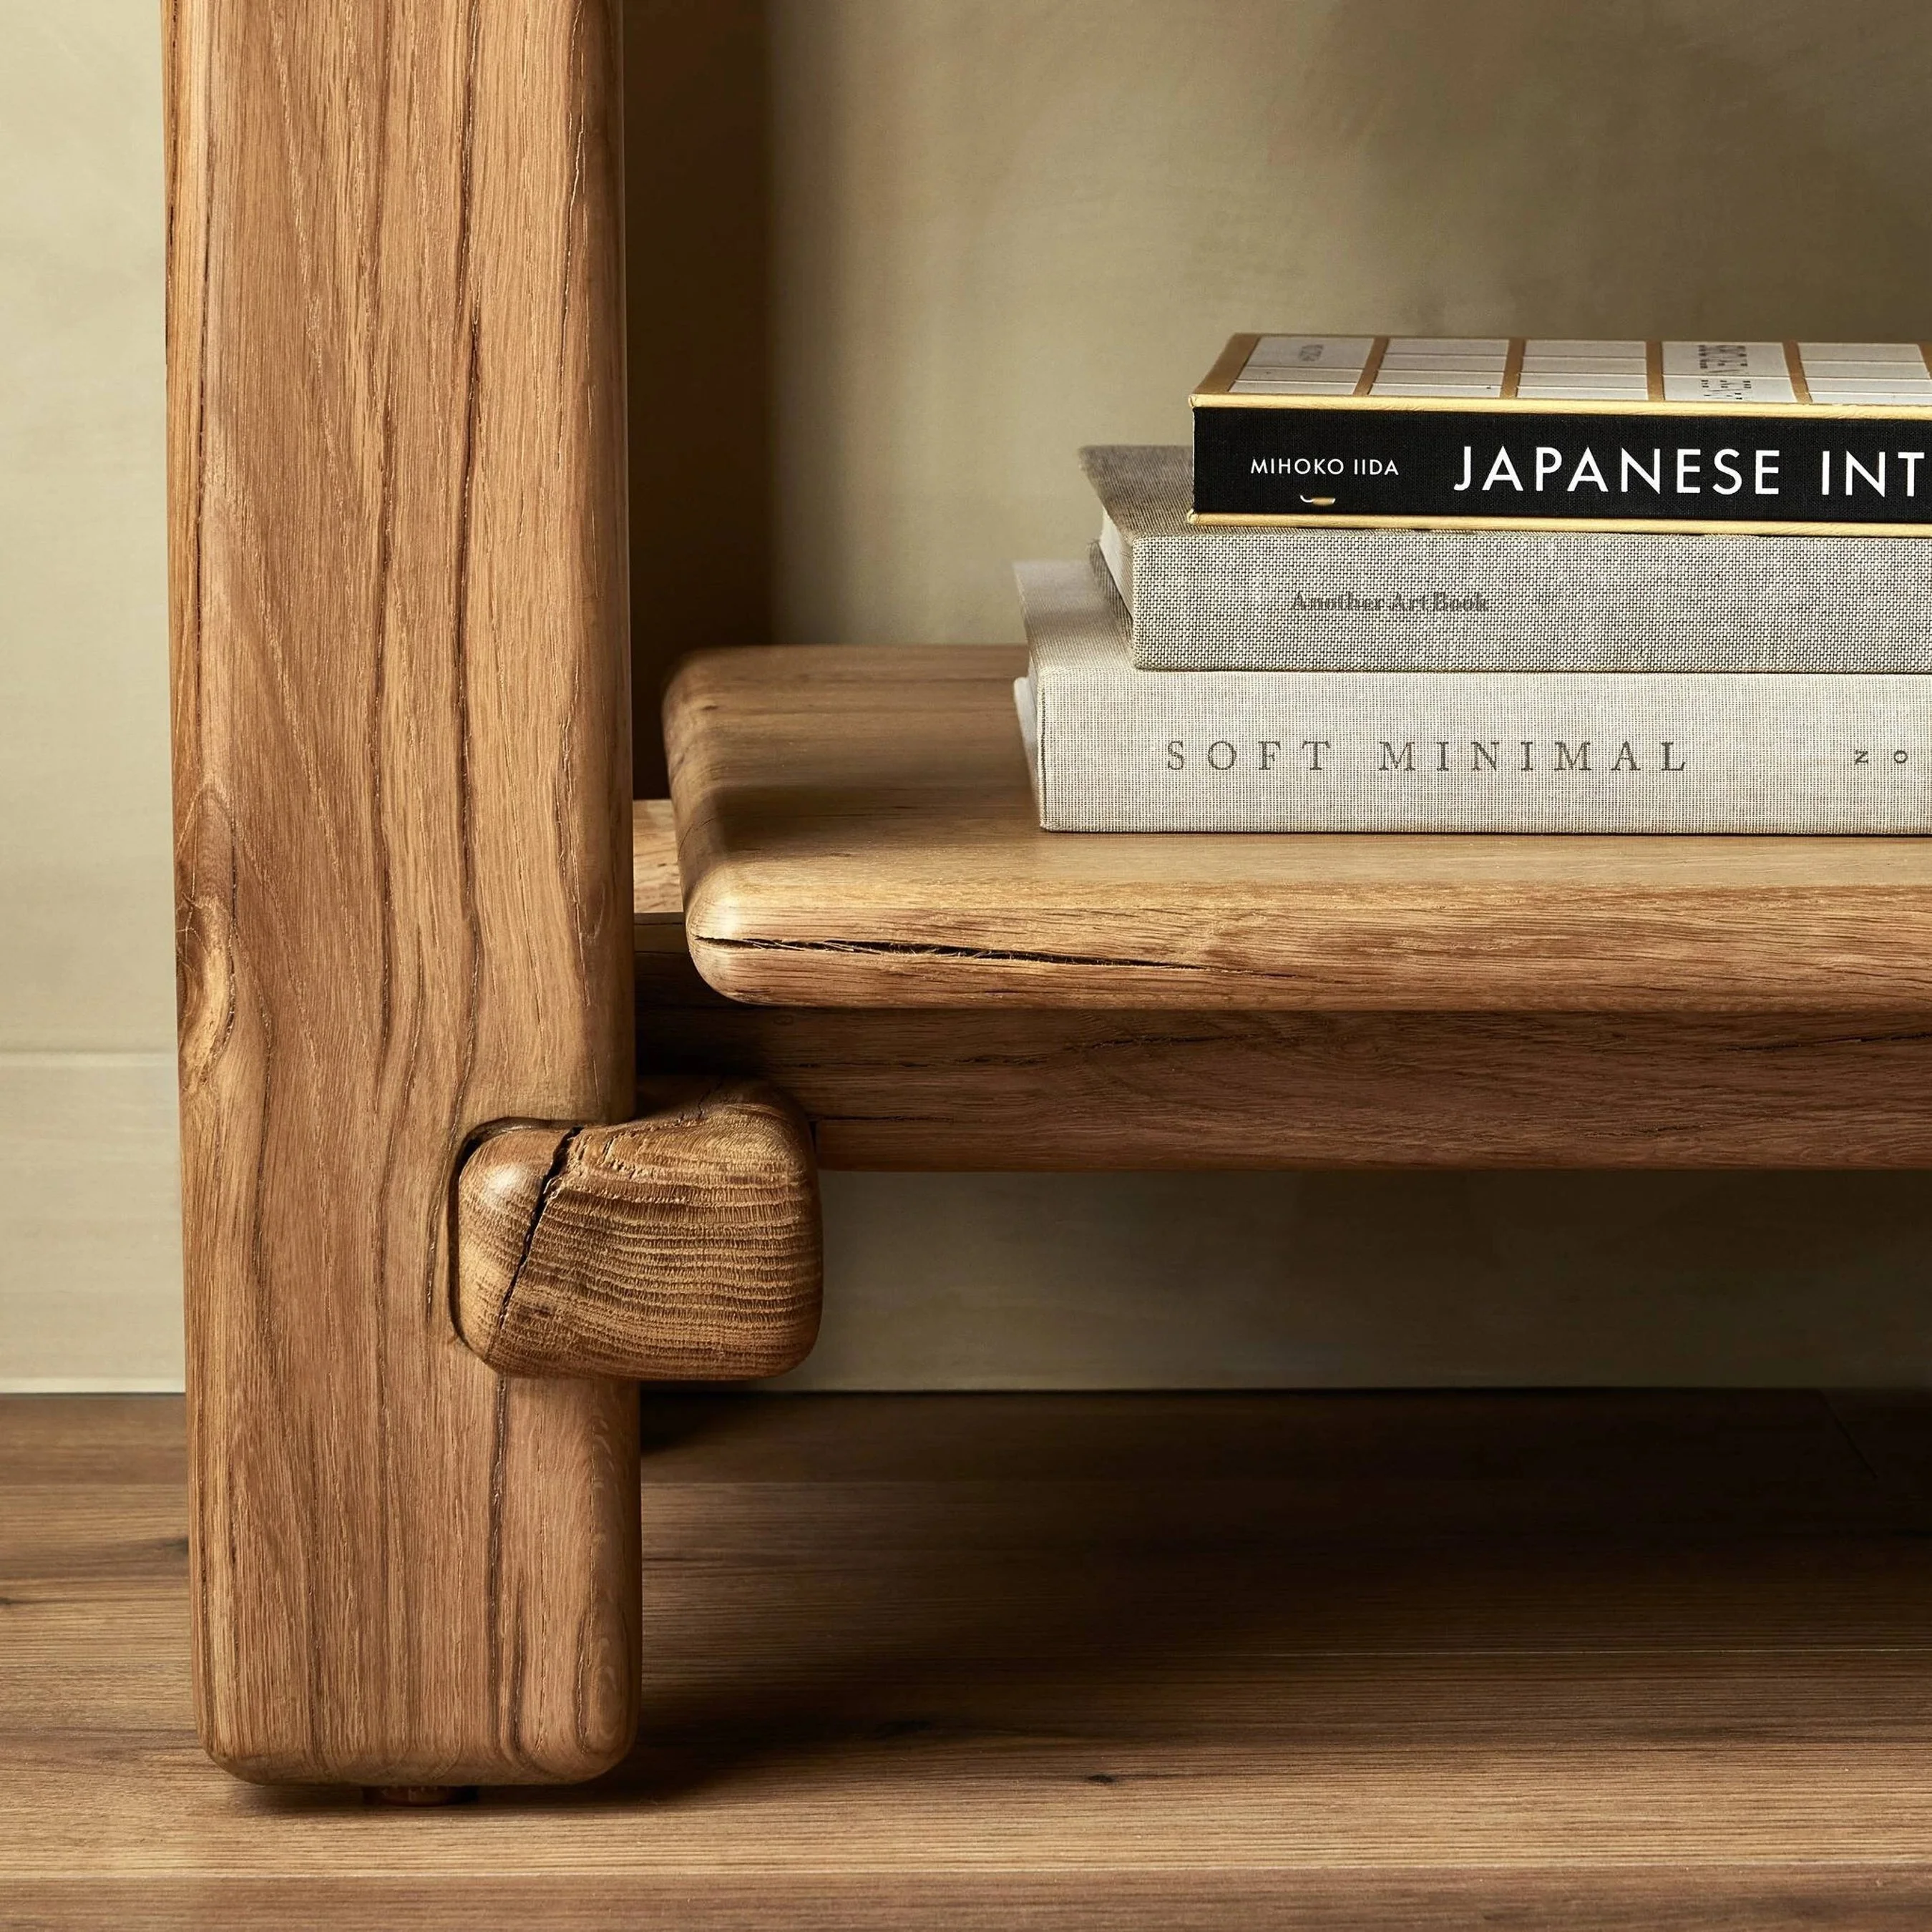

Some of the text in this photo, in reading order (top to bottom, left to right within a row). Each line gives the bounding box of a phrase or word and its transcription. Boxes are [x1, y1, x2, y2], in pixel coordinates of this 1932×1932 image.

[1250, 458, 1399, 476] MIHOKO IIDA
[1453, 445, 1925, 497] JAPANESE INT
[1293, 592, 1490, 612] Another Art Book
[1167, 740, 1686, 771] SOFT MINIMAL
